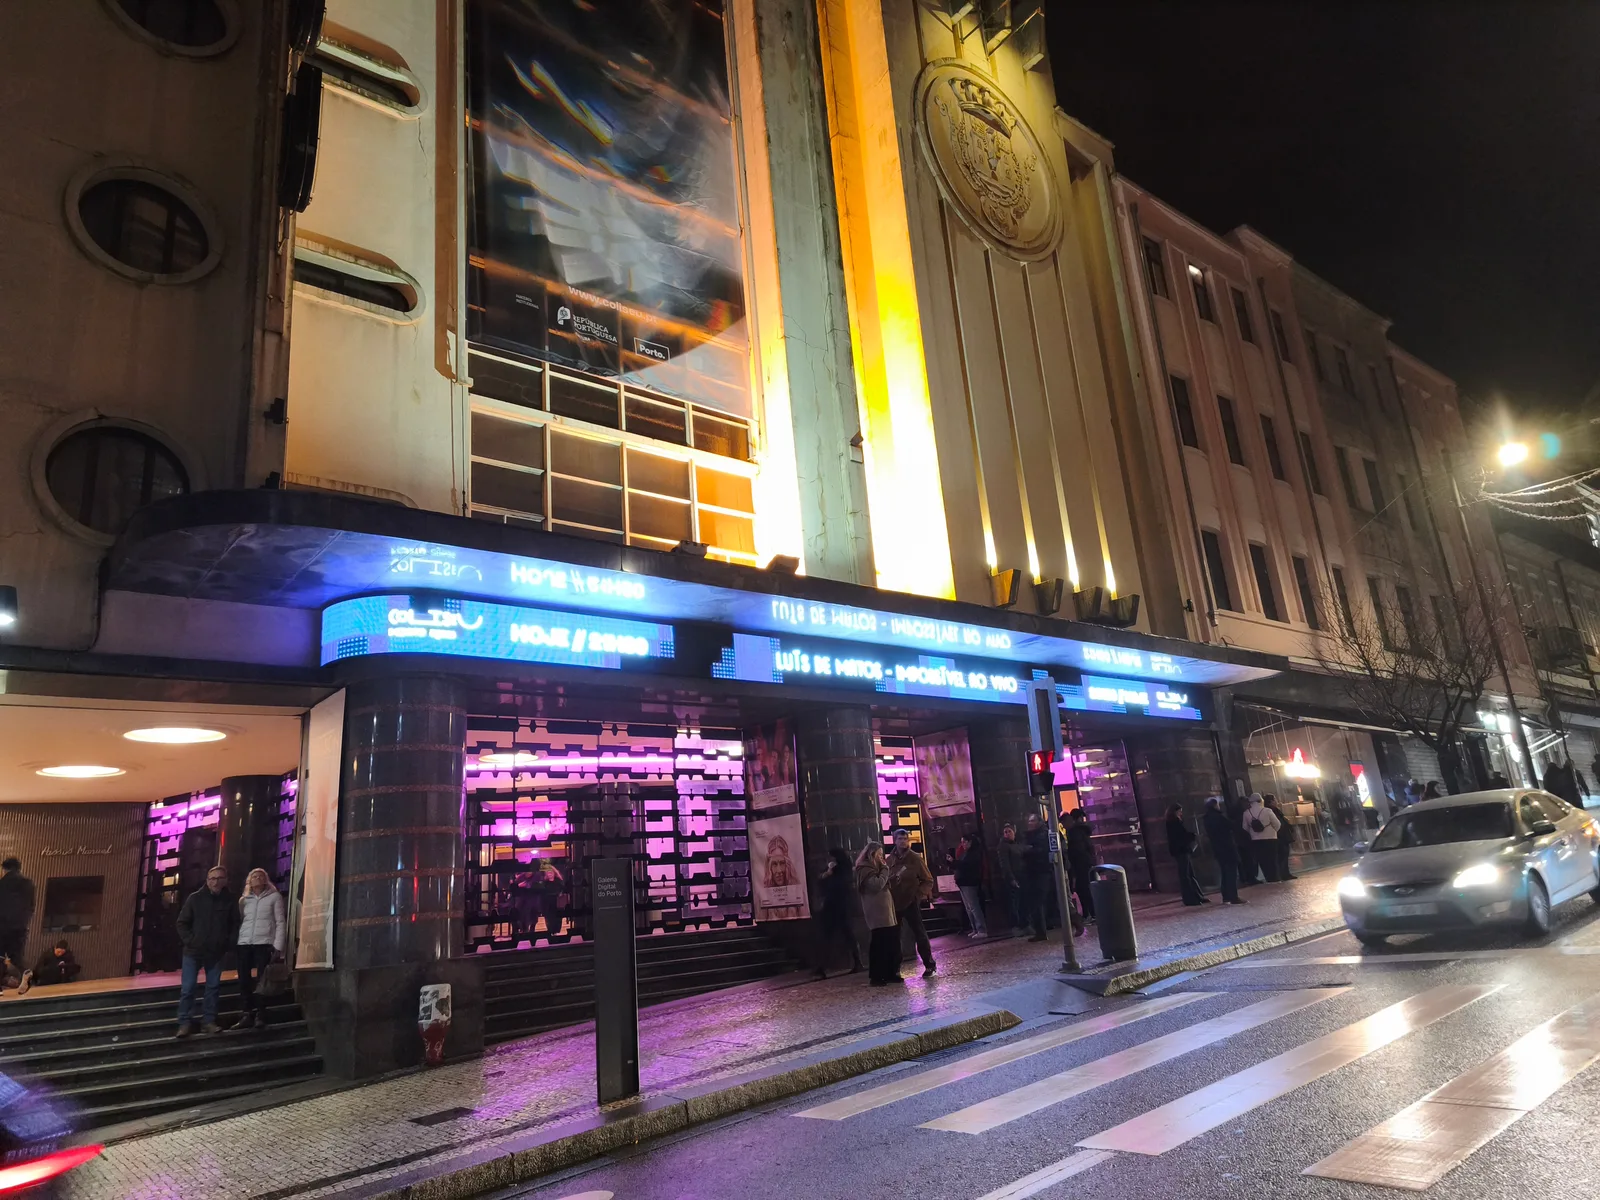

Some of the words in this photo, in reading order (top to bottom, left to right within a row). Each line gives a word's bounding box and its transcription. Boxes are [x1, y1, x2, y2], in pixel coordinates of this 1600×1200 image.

[568, 286, 658, 324] www.coliseu.pt
[572, 314, 609, 333] REPÚBLICA
[573, 321, 618, 343] PORTUGUESA
[639, 344, 666, 360] Porto.
[510, 623, 570, 648] HOJE
[814, 655, 832, 676] DE
